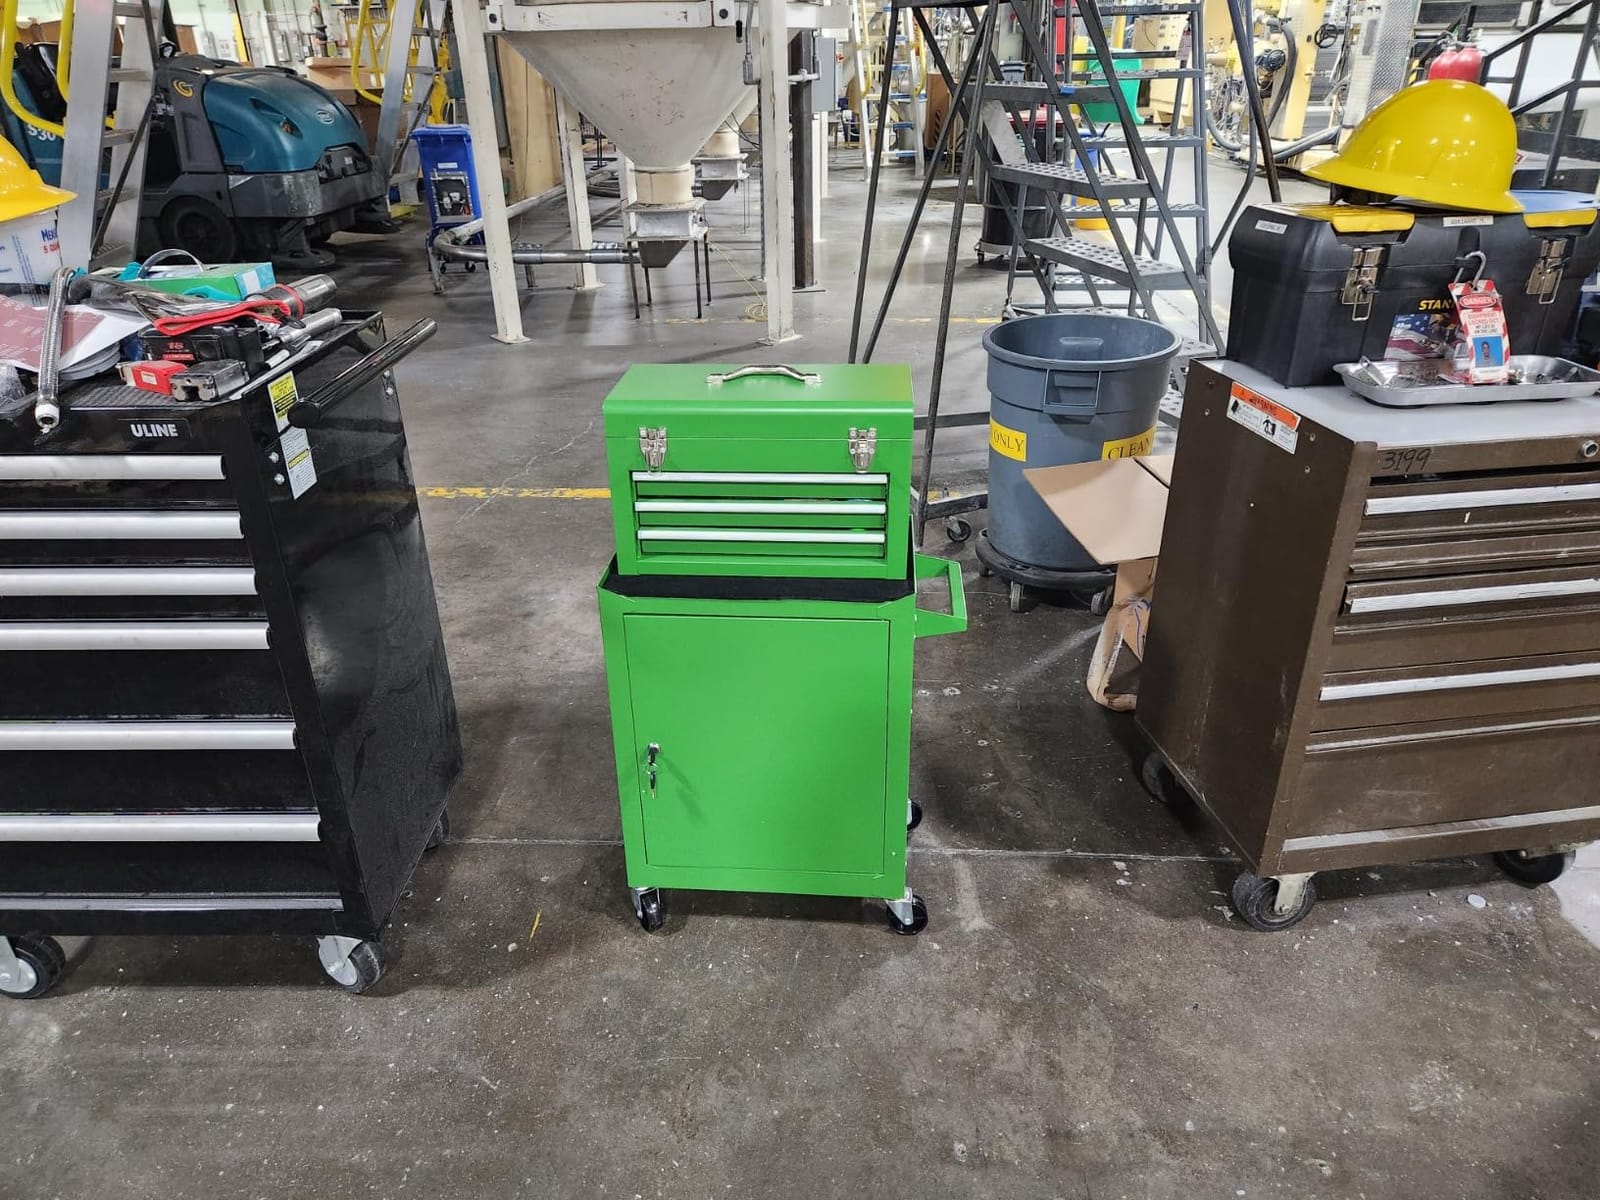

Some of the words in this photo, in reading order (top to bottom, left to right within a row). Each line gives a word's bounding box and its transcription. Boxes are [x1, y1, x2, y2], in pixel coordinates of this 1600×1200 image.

[1418, 299, 1452, 311] STAN
[130, 423, 179, 437] ULINE
[993, 430, 1025, 451] ONLY
[1108, 437, 1152, 459] CLEAN
[1381, 448, 1432, 473] 3199
